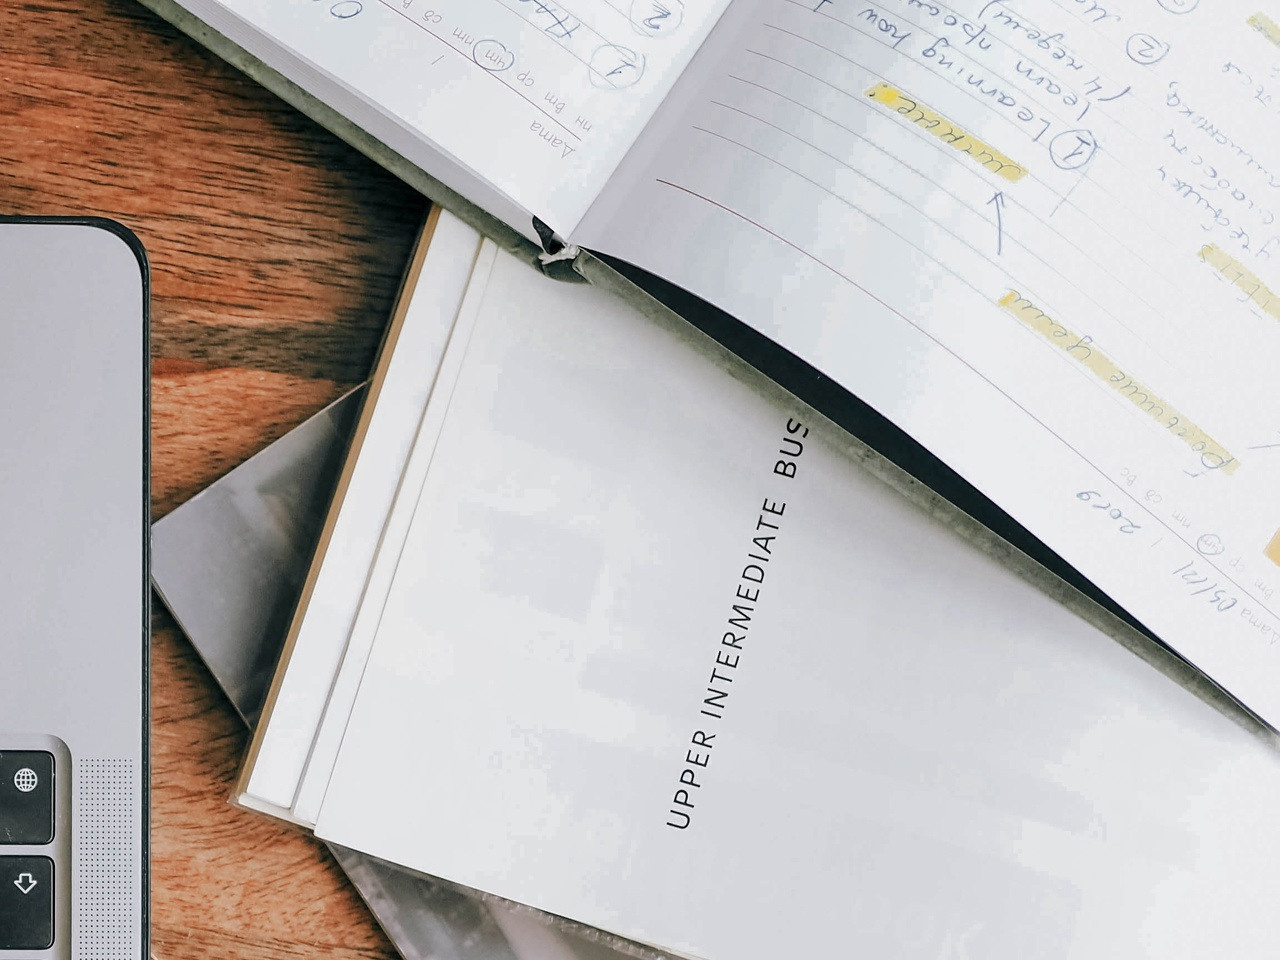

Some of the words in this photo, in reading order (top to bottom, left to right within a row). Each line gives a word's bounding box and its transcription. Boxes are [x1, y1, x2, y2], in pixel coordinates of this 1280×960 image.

[855, 7, 912, 51] how
[920, 36, 1050, 143] Learning
[1015, 60, 1091, 122] learn
[666, 730, 716, 830] UPPER
[700, 498, 786, 719] INTERMEDIATE
